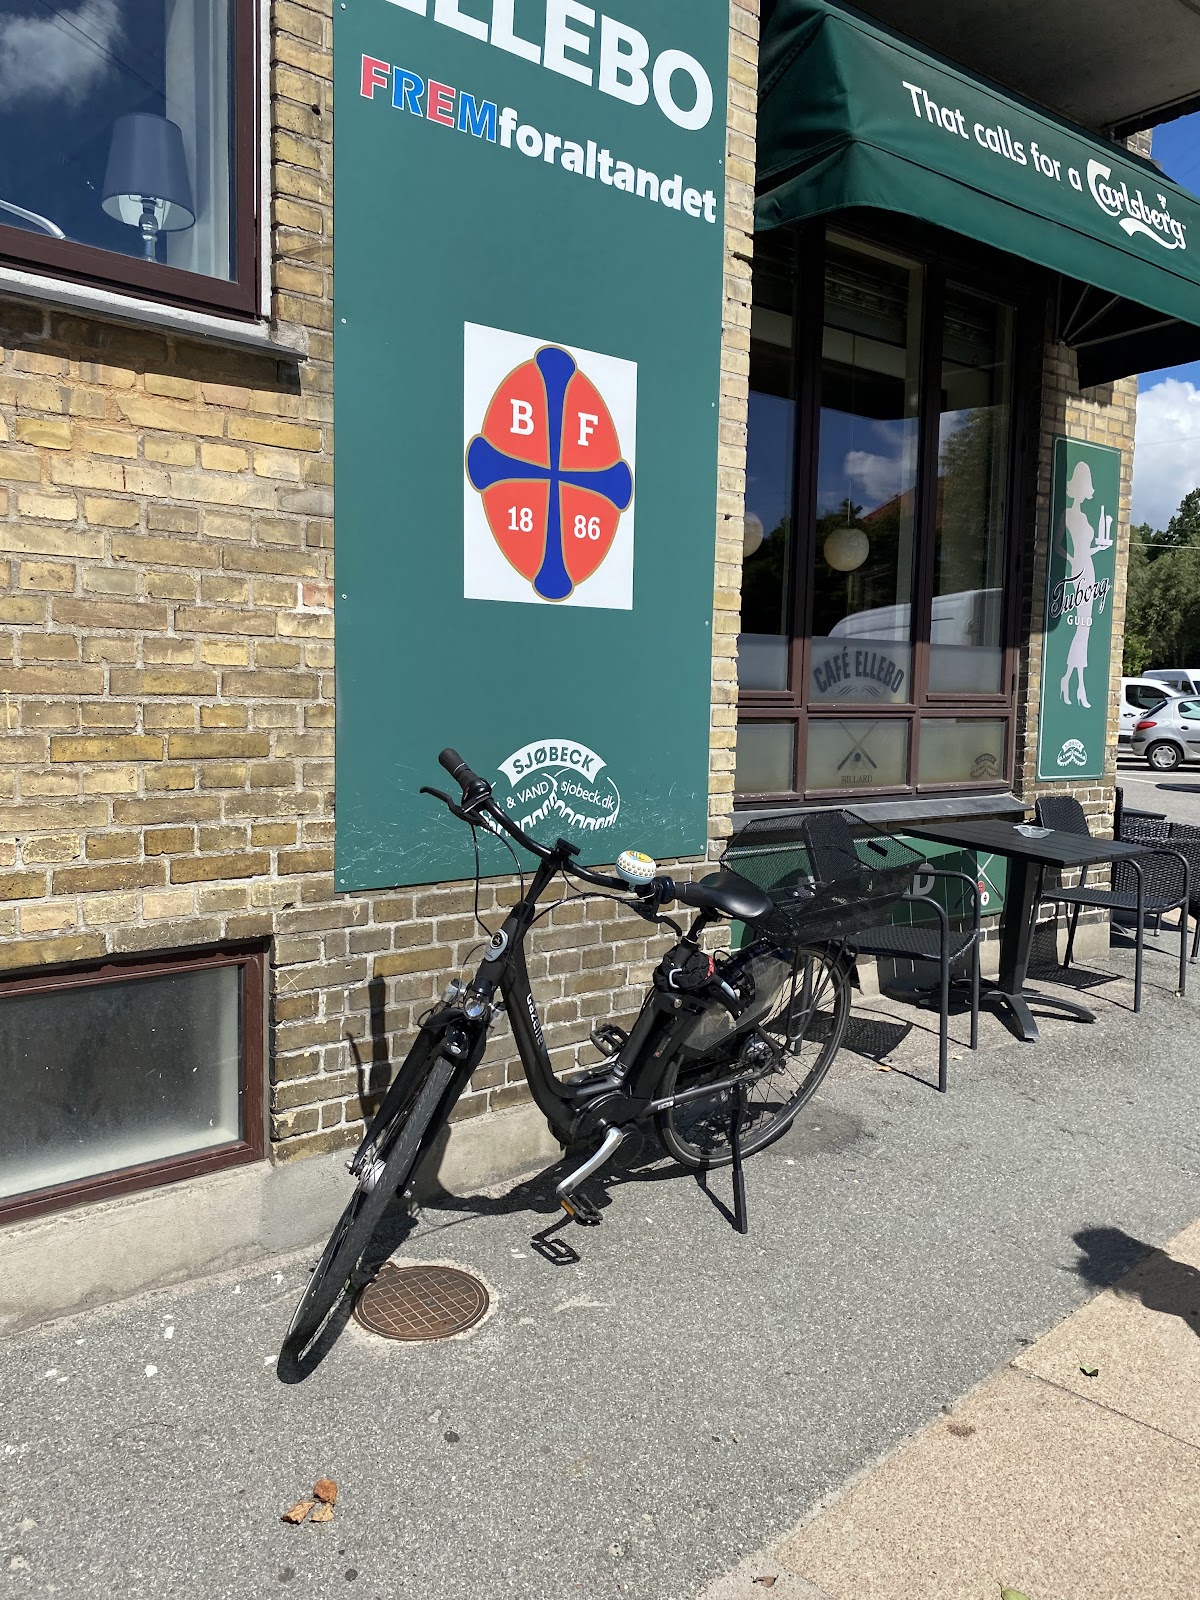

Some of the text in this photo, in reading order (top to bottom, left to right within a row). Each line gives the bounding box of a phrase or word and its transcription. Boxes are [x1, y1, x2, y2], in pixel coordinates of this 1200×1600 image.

[360, 53, 717, 224] FREMforaltandet
[902, 81, 1187, 250] That calls for a Carlsberg
[510, 398, 598, 446] B F
[508, 506, 601, 540] 18 86
[1050, 567, 1109, 618] Tuborg
[1066, 614, 1093, 627] GULD
[813, 645, 905, 694] CAFÉ ELLEBO
[512, 746, 595, 775] SJØBECK
[517, 781, 549, 804] VAND
[560, 779, 616, 811] sjobeck.dk
[841, 774, 873, 784] BILLARD
